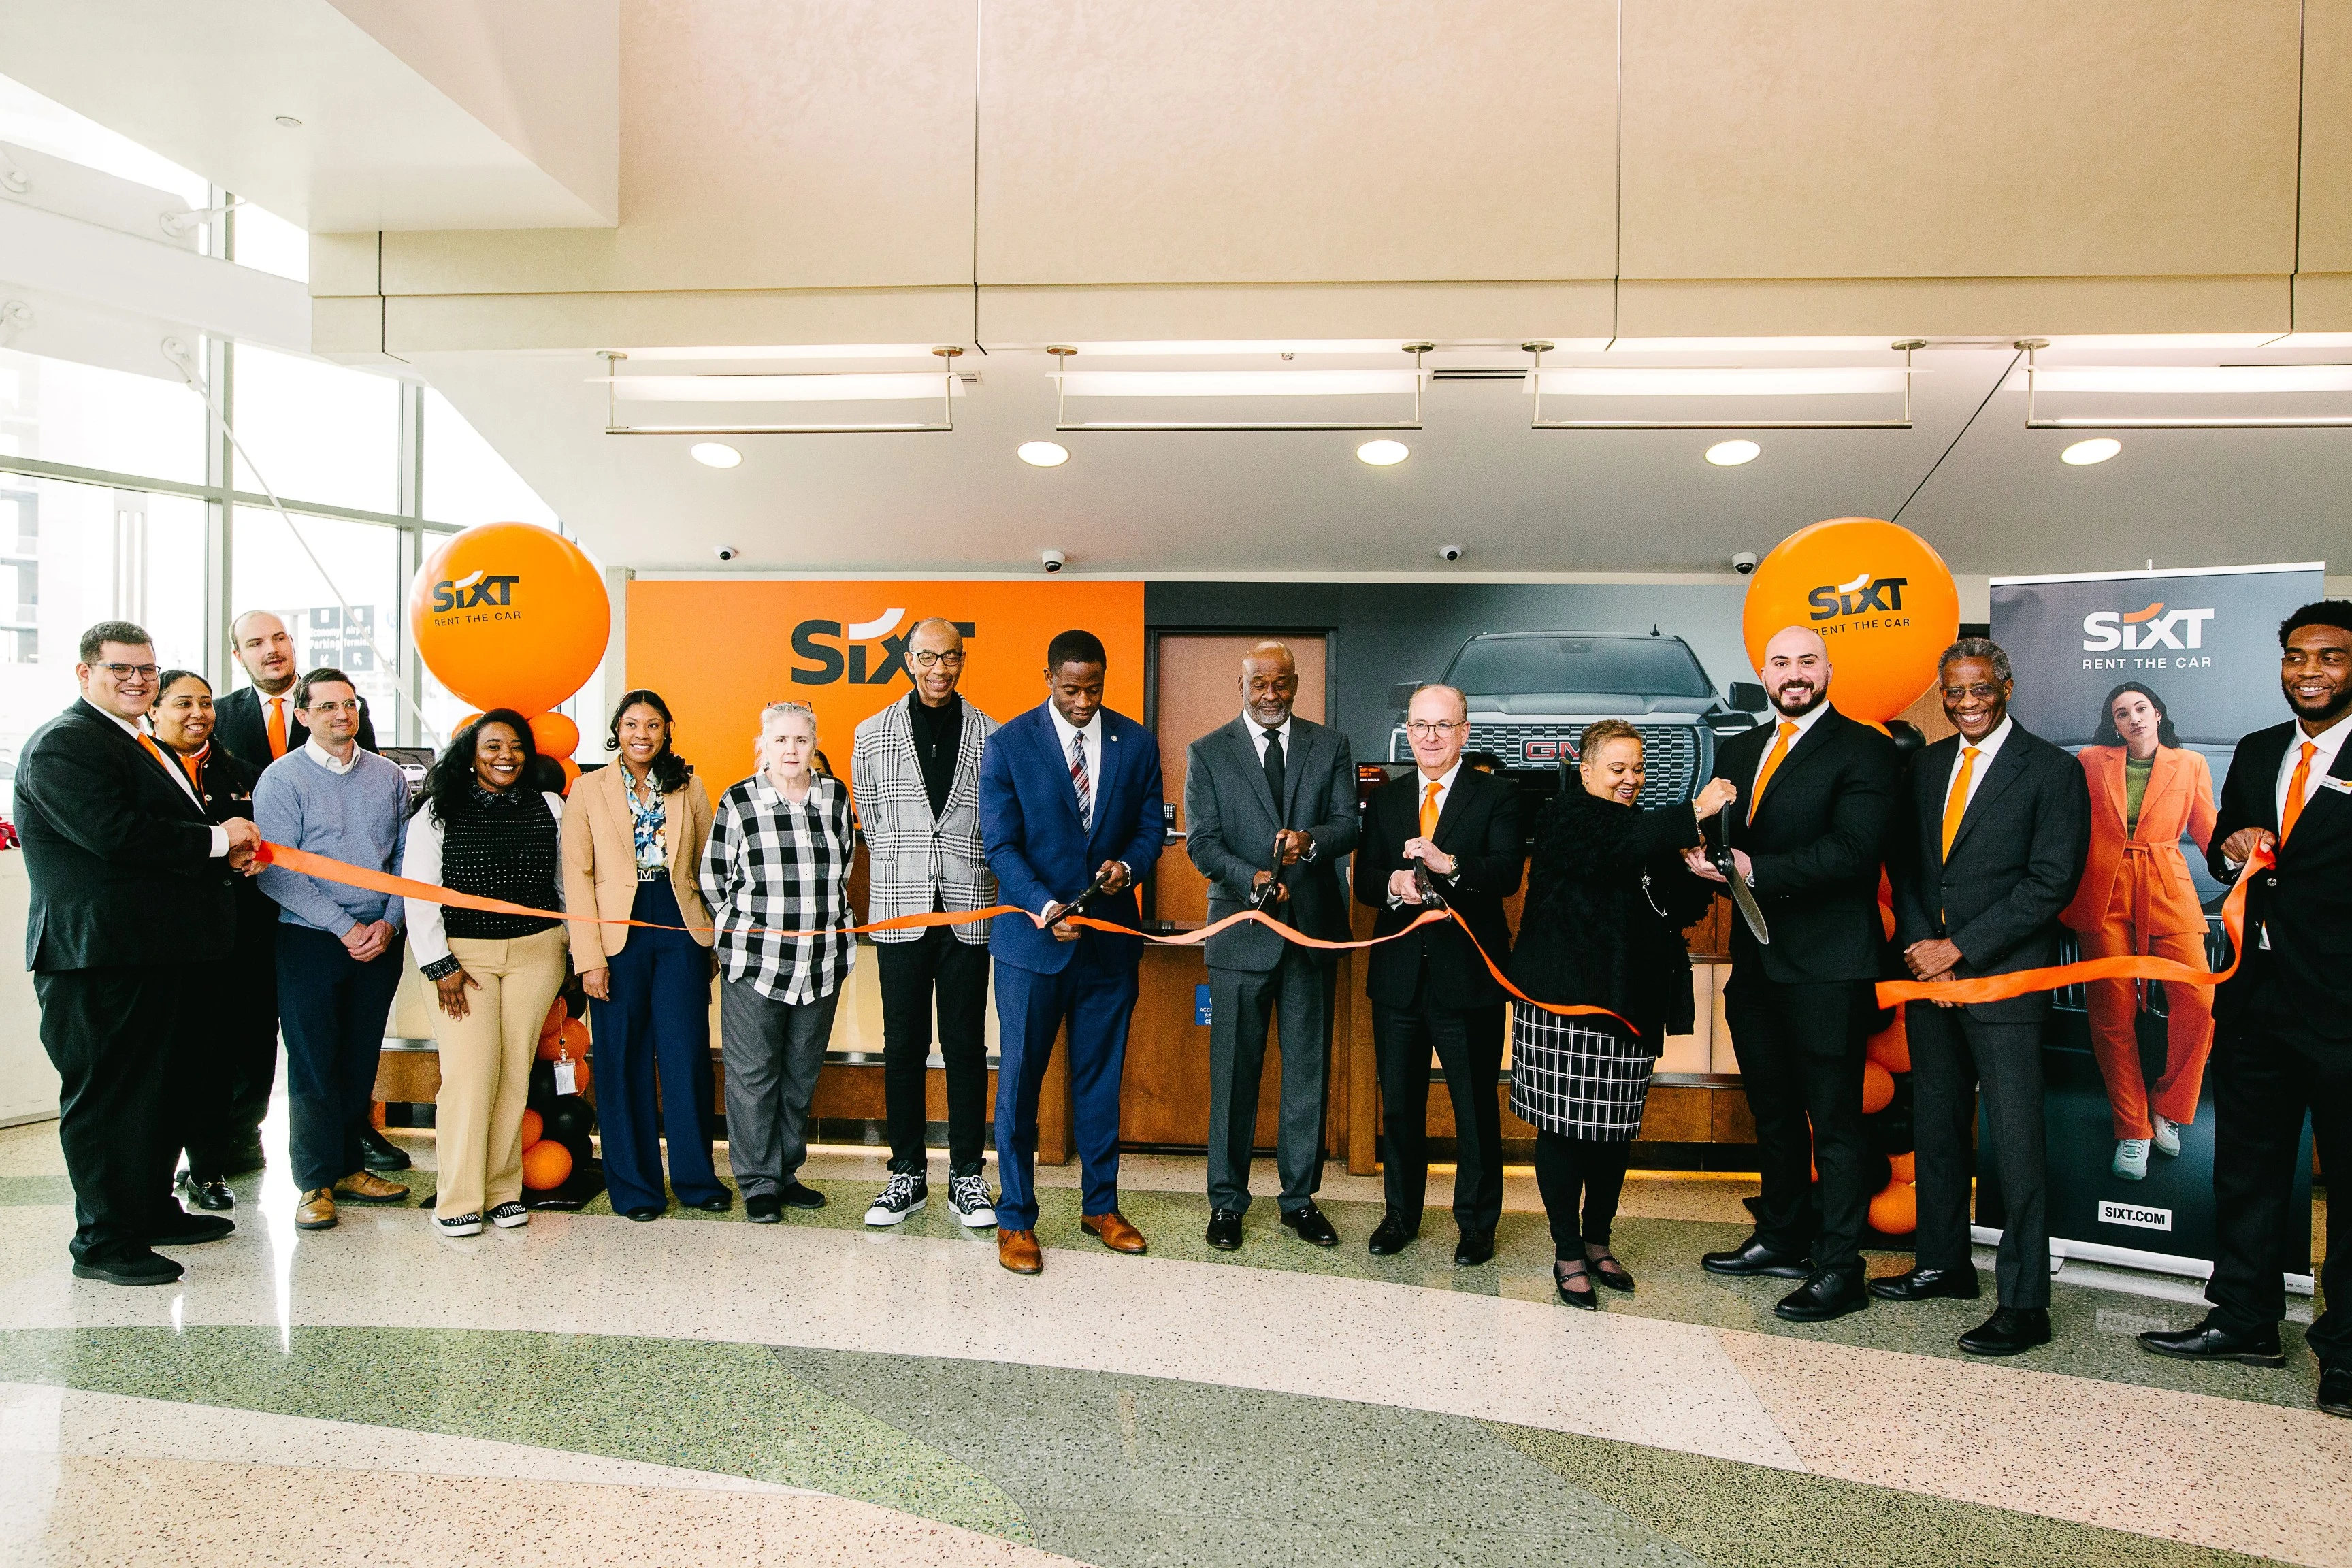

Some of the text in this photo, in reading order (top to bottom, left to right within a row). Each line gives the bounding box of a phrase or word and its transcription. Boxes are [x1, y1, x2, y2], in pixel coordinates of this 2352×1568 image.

[434, 611, 521, 627] RENT THE CAR
[1853, 620, 1878, 630] THE
[1884, 618, 1910, 627] CAR
[310, 627, 340, 639] Economy
[345, 625, 372, 636] Airprt
[310, 638, 340, 651] Parking
[2082, 657, 2212, 670] RENT THE CAR
[1526, 741, 1580, 760] GM
[2104, 1207, 2166, 1225] SIXT.COM
